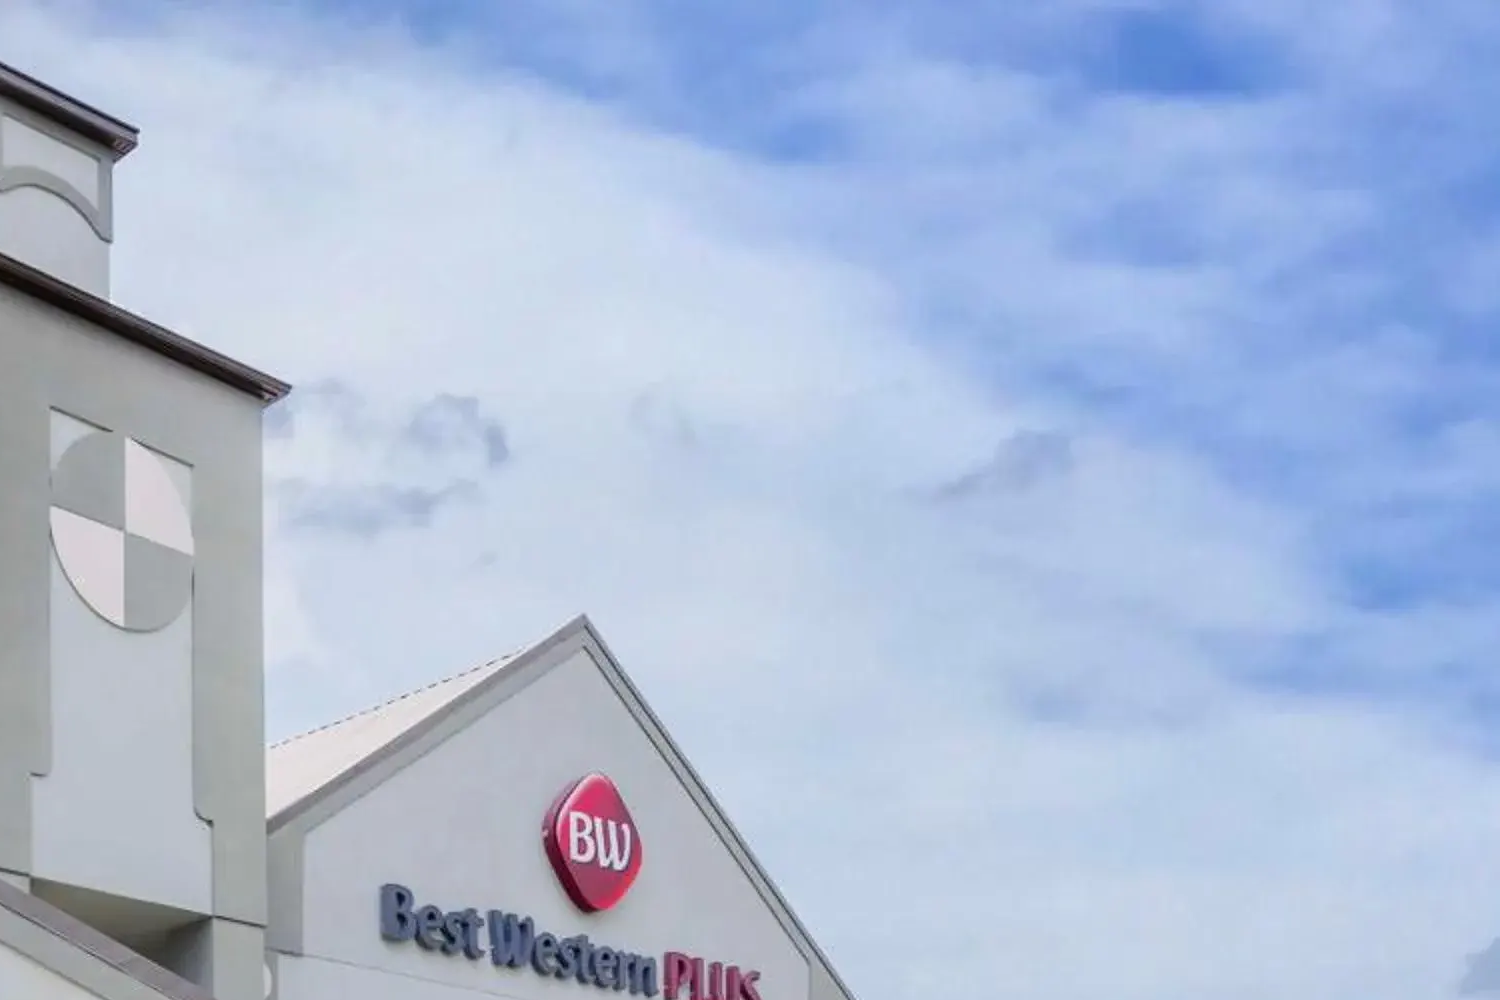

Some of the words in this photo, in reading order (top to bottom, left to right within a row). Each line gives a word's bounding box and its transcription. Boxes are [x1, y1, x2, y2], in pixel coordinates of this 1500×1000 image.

[569, 811, 632, 871] BW
[380, 882, 486, 959] Best
[487, 909, 659, 998] Western
